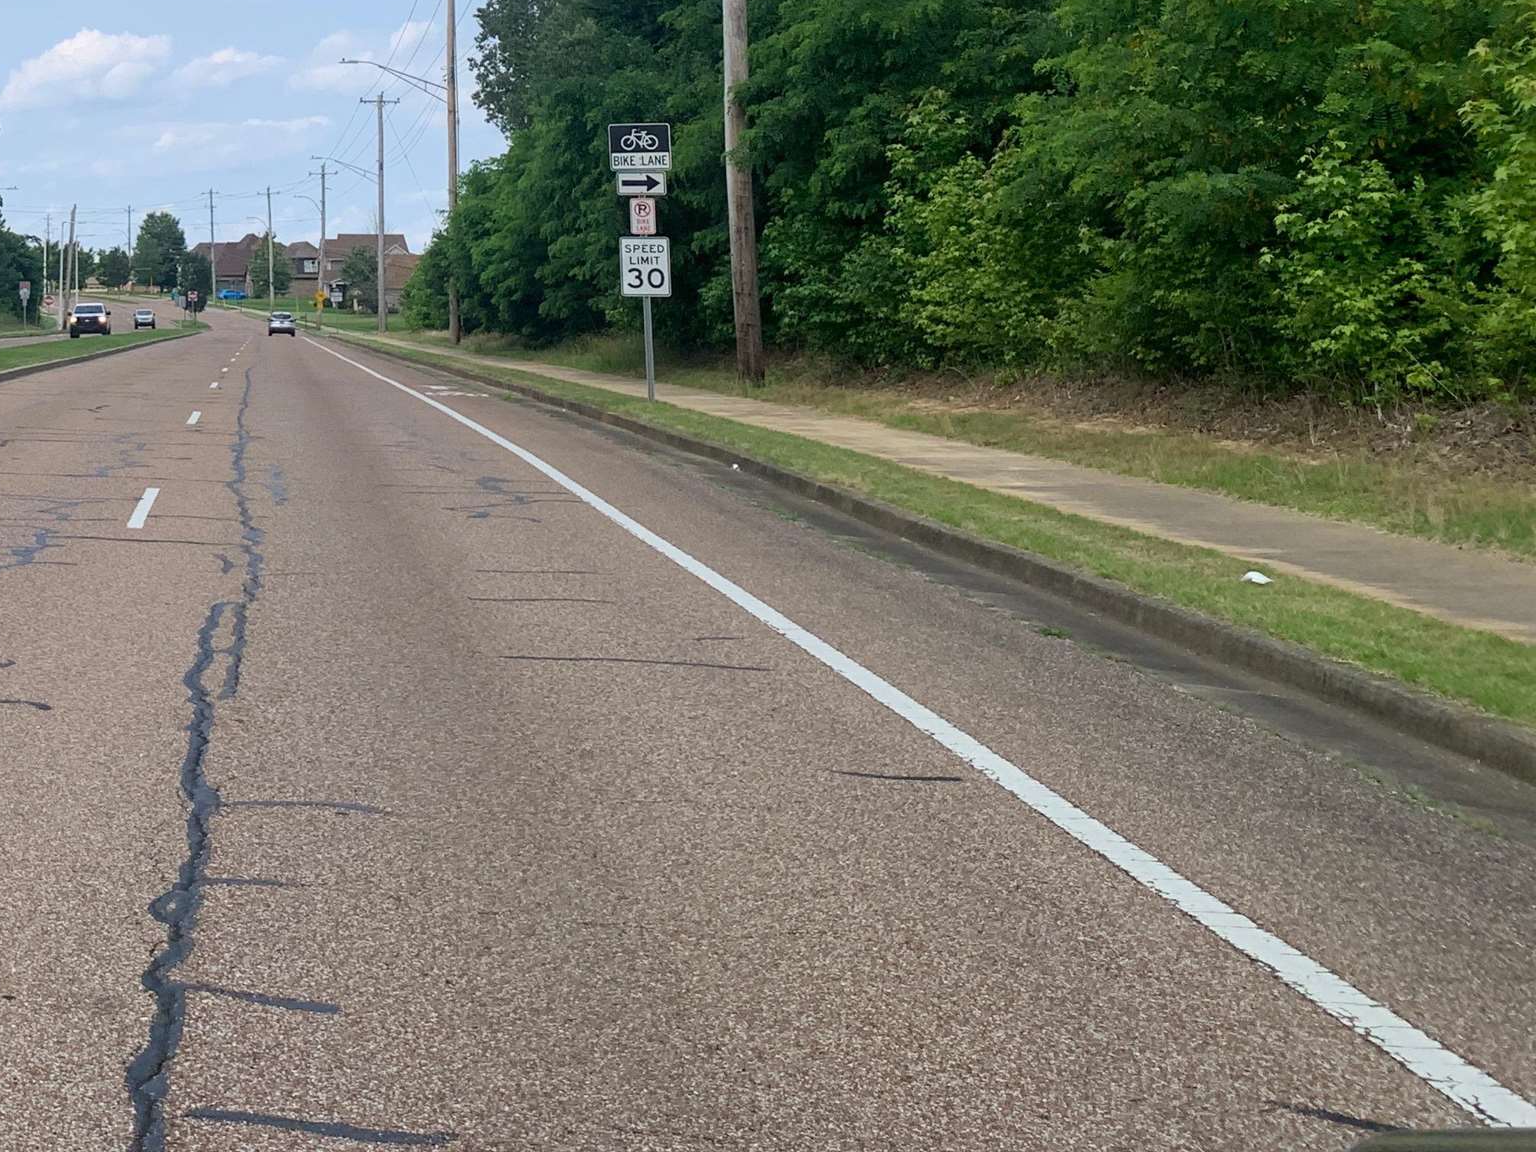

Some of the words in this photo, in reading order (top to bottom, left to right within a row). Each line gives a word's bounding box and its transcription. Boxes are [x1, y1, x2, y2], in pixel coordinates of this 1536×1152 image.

[614, 155, 636, 166] BIKE
[641, 154, 668, 166] LANE
[624, 244, 665, 254] SPEED
[629, 256, 661, 265] LIMIT
[627, 268, 665, 289] 30
